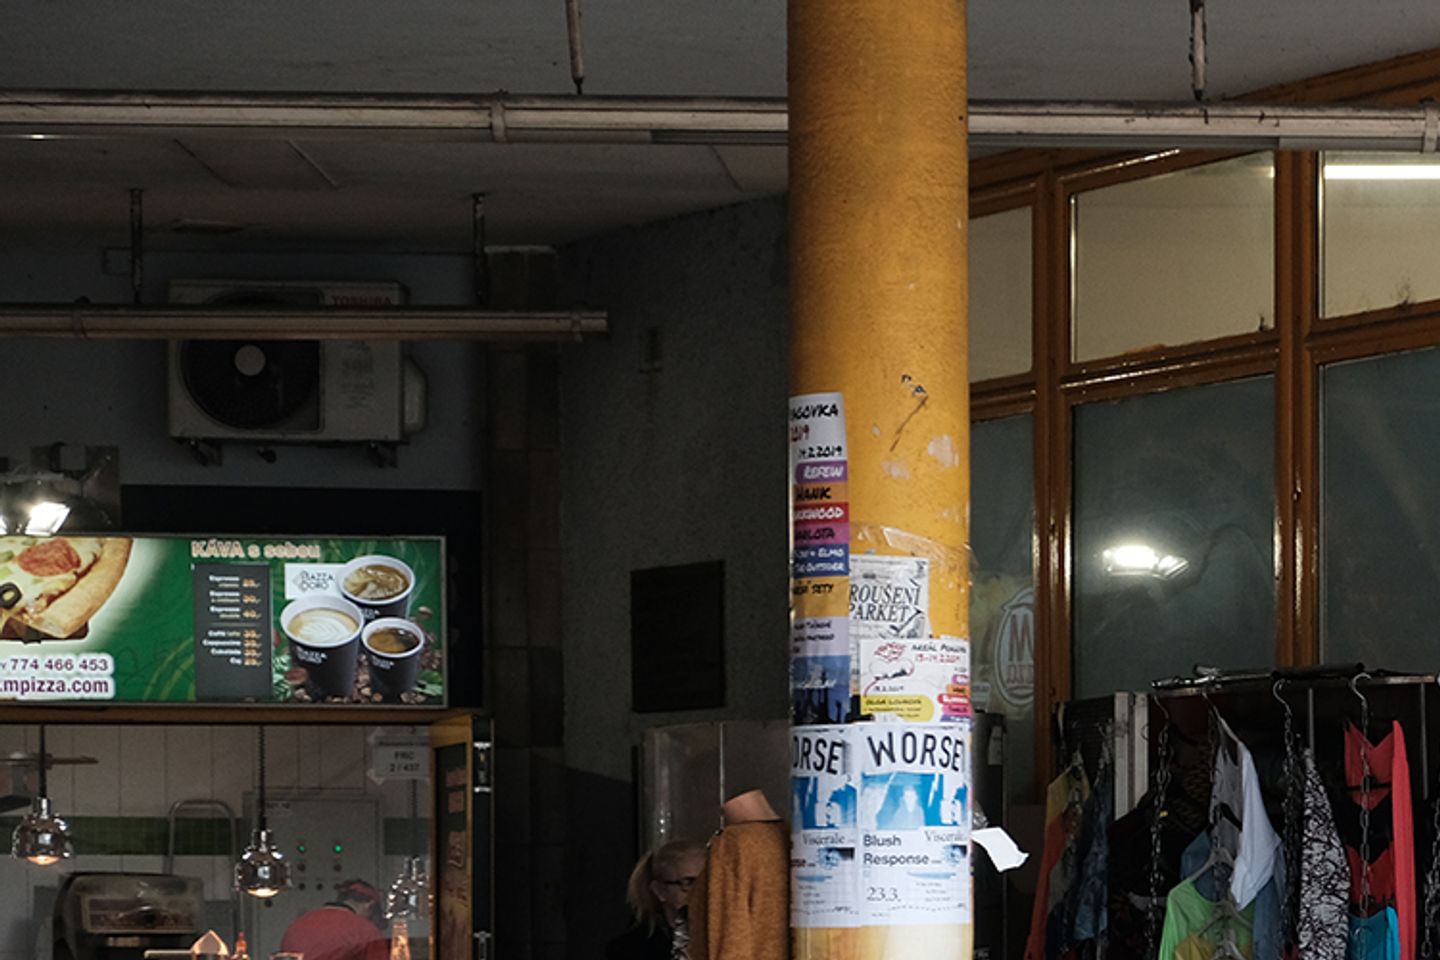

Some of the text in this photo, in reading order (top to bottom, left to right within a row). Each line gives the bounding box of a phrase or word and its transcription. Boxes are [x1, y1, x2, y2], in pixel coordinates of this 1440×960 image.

[849, 581, 921, 606] ROUŠENÍ
[10, 658, 39, 671] 774
[44, 658, 74, 671] 466
[79, 658, 108, 671] 453
[866, 731, 964, 772] WORSE
[863, 834, 902, 848] Blush
[863, 852, 930, 868] Response
[866, 886, 902, 903] 23.3.
